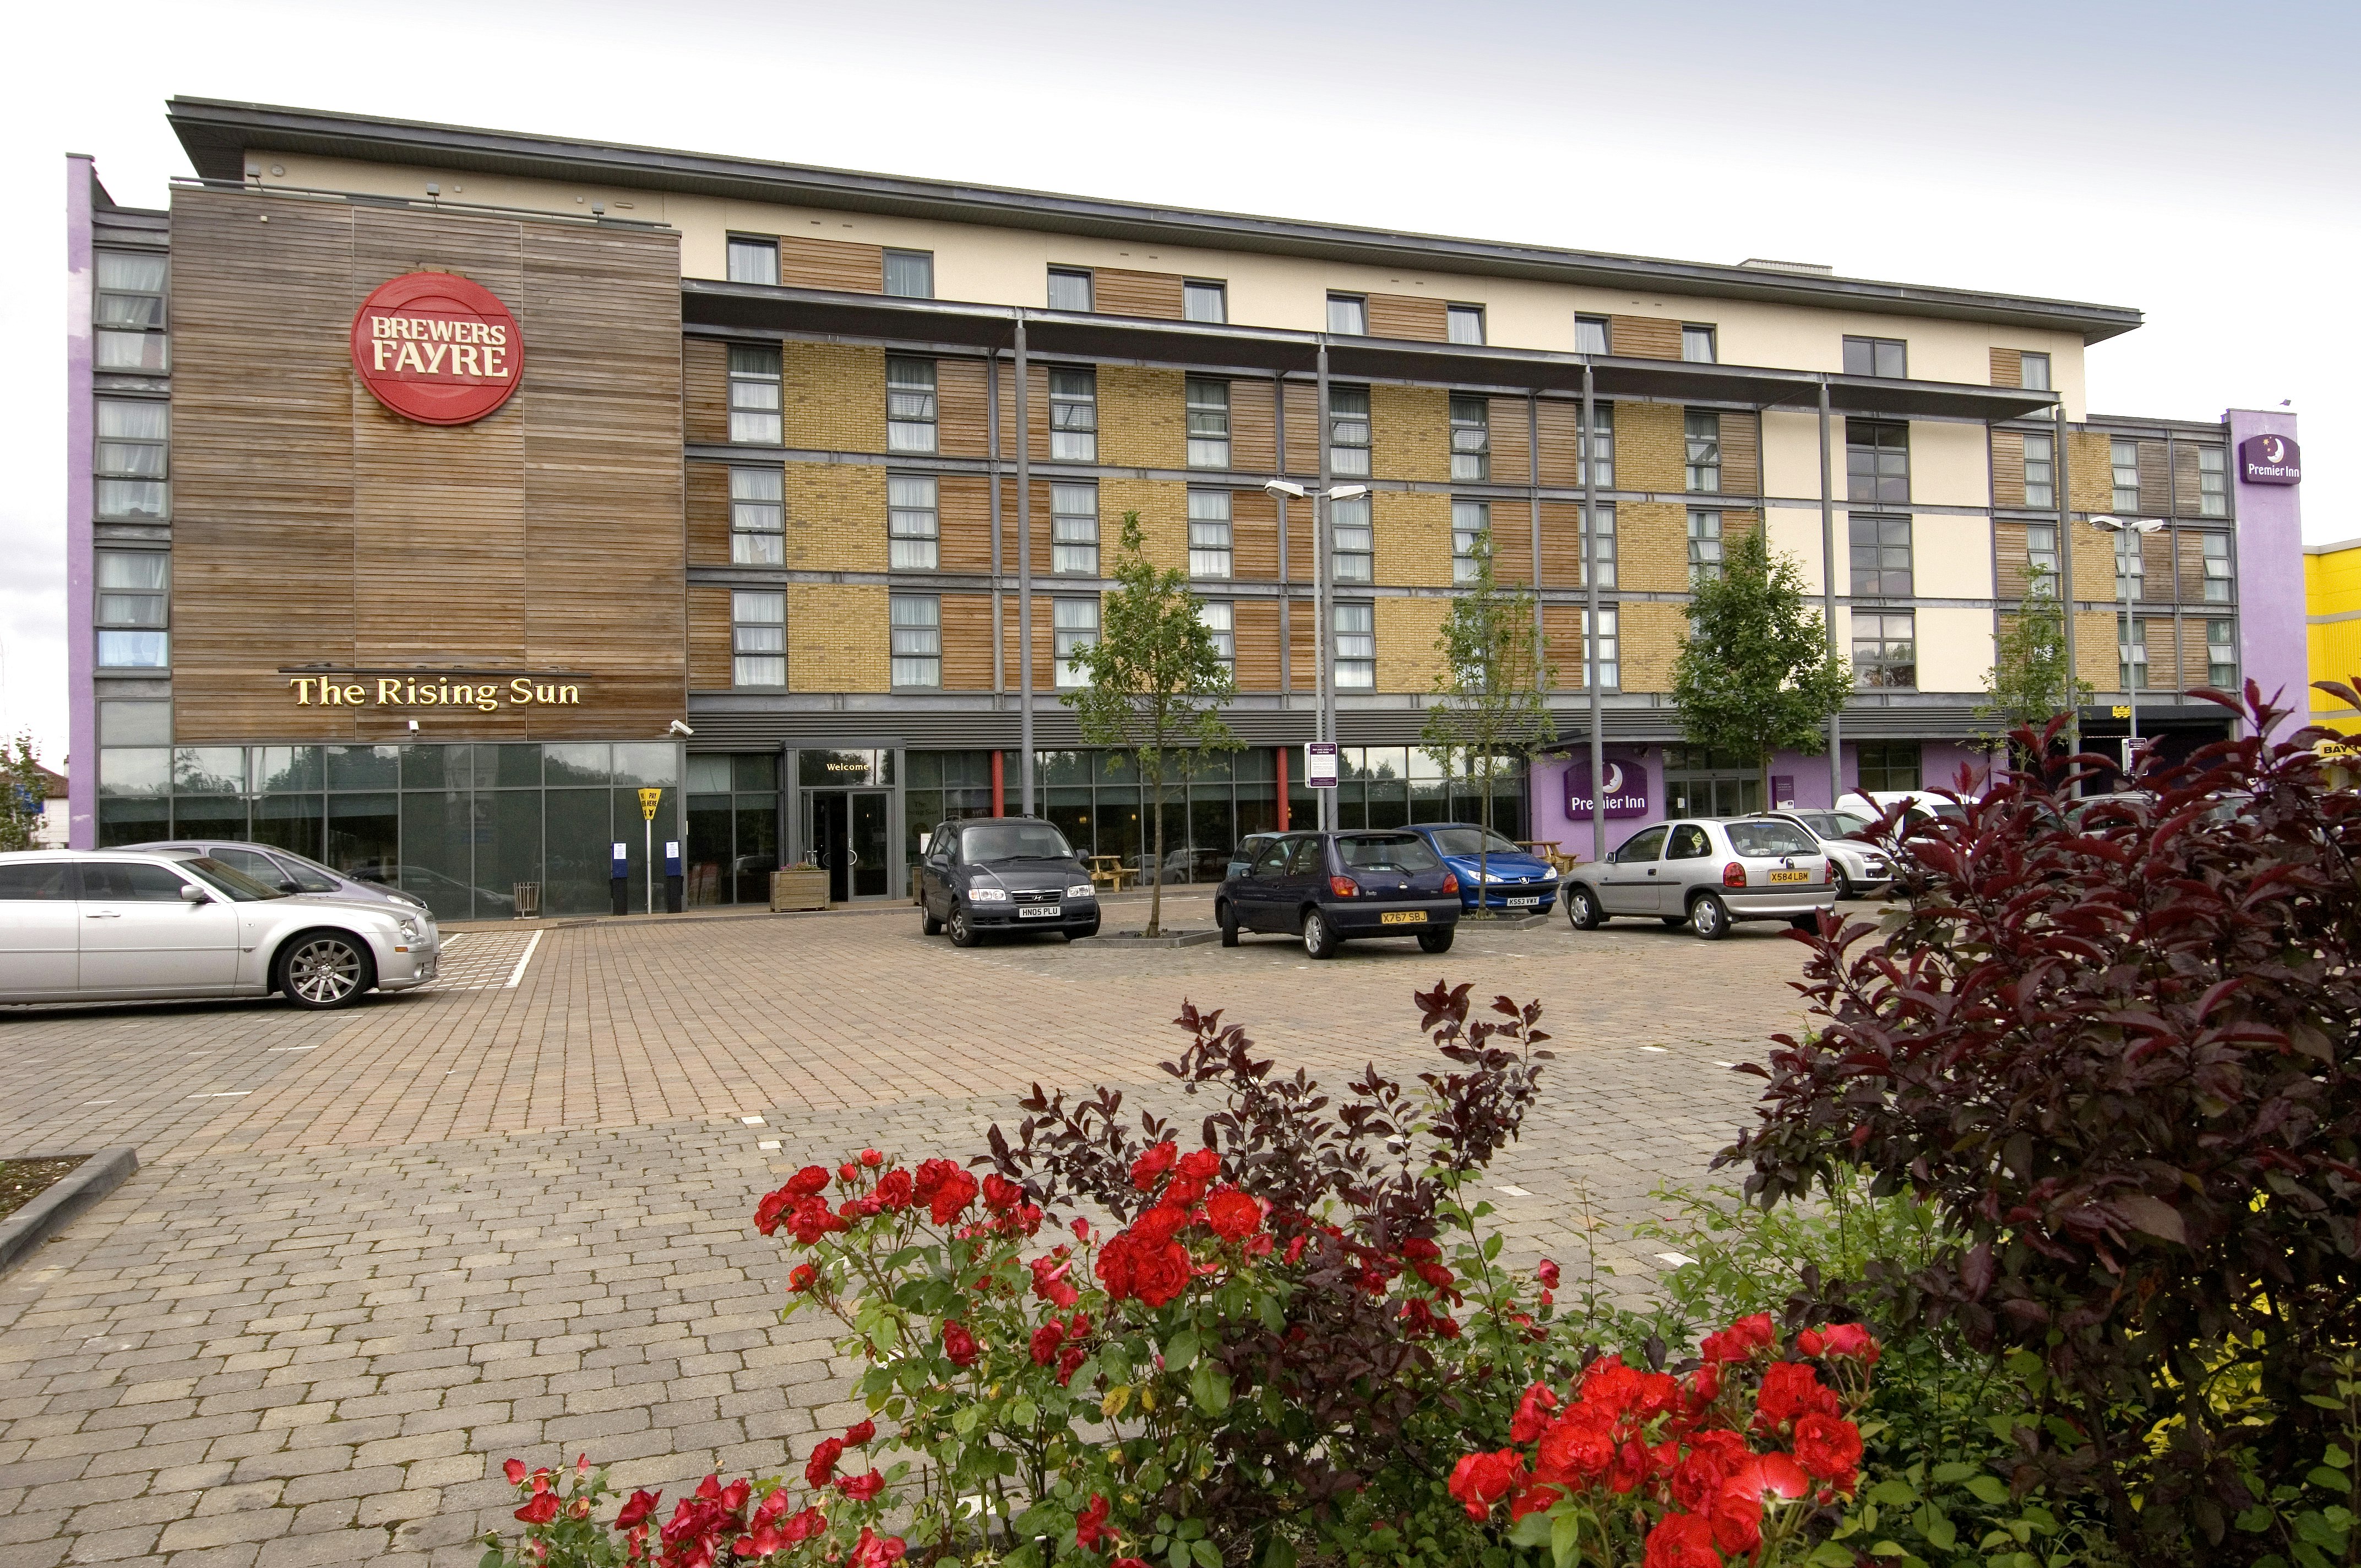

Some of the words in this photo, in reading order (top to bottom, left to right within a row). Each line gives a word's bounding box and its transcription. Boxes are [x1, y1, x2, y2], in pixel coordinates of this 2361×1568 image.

[371, 315, 507, 346] BREWERS
[371, 339, 508, 378] FAYRE
[2248, 463, 2284, 476] Premier
[2286, 465, 2299, 477] Inn
[290, 676, 366, 705] The
[376, 677, 498, 712] Rising
[509, 677, 580, 705] Sun
[2324, 745, 2347, 754] BAY
[826, 763, 869, 771] Welcome
[1571, 796, 1623, 811] Preier
[1625, 795, 1645, 808] Inn
[1771, 873, 1792, 881] X584
[1383, 913, 1406, 923] X767
[1408, 912, 1426, 921] SBJ
